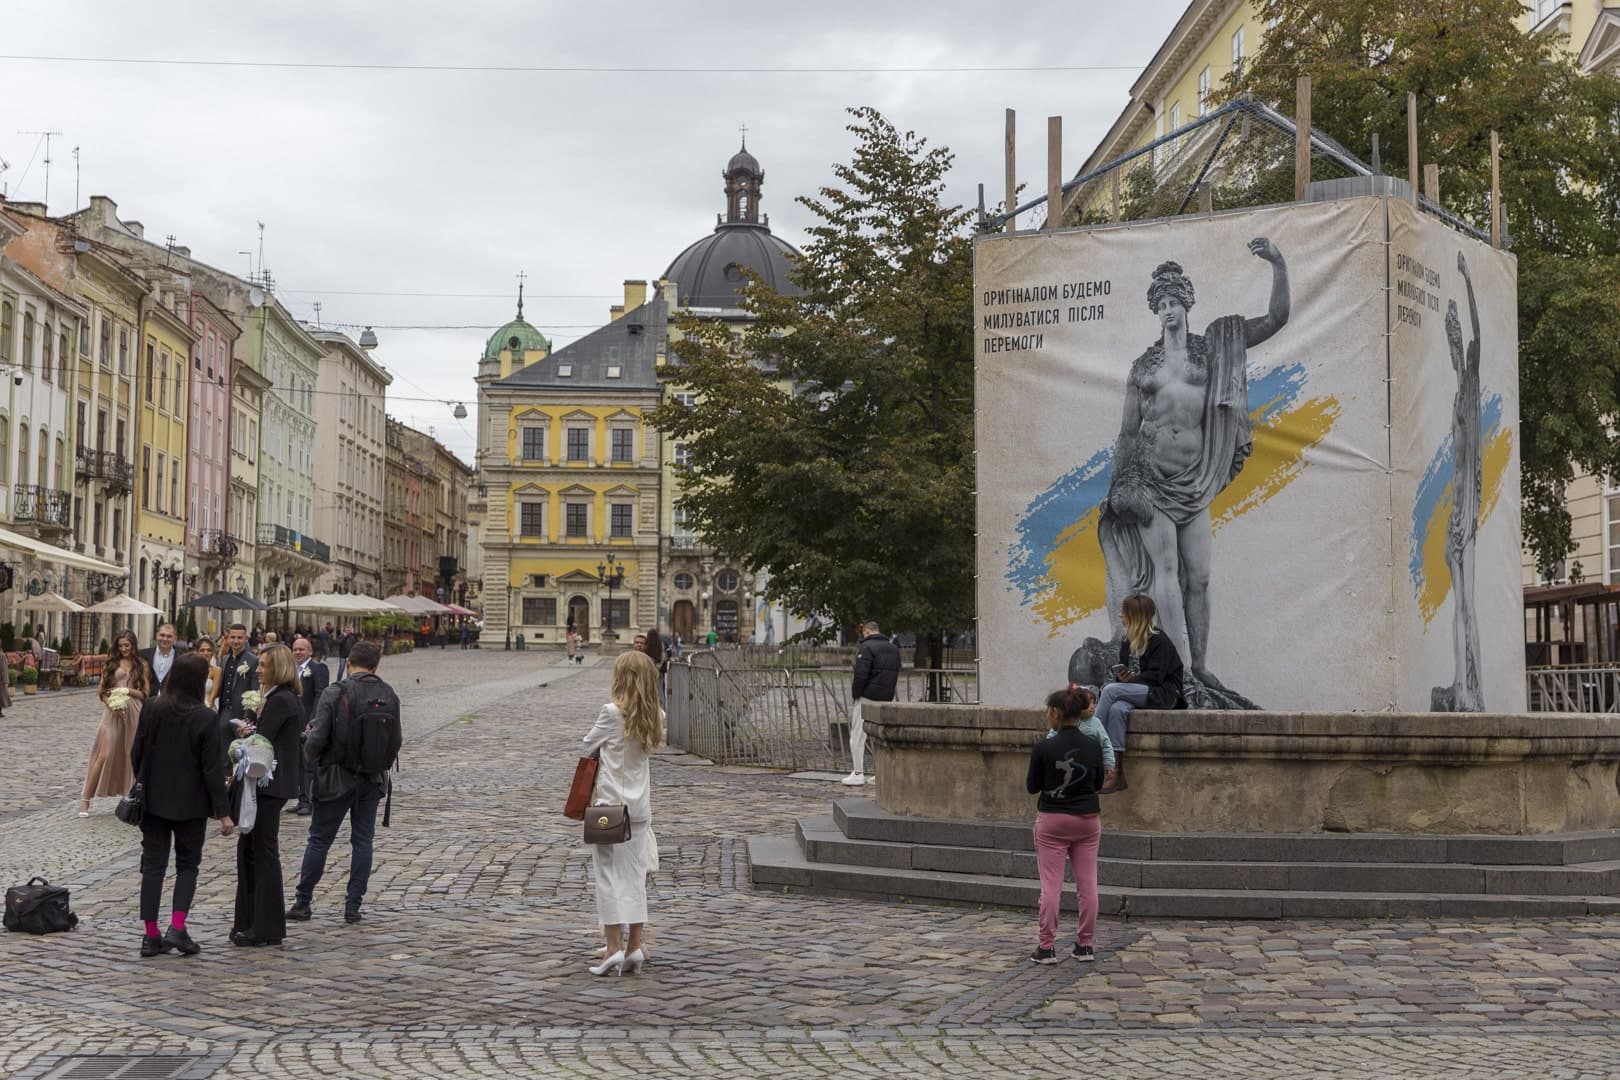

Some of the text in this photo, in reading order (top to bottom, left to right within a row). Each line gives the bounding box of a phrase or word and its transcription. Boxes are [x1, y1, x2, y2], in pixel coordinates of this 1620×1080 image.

[983, 280, 1111, 306] ОРИГІНАЛОМ БУДЕМО
[983, 305, 1104, 330] МИЛУВАТИСЯ ПІСЛЯ
[983, 334, 1043, 353] ПЕРЕМОГИ
